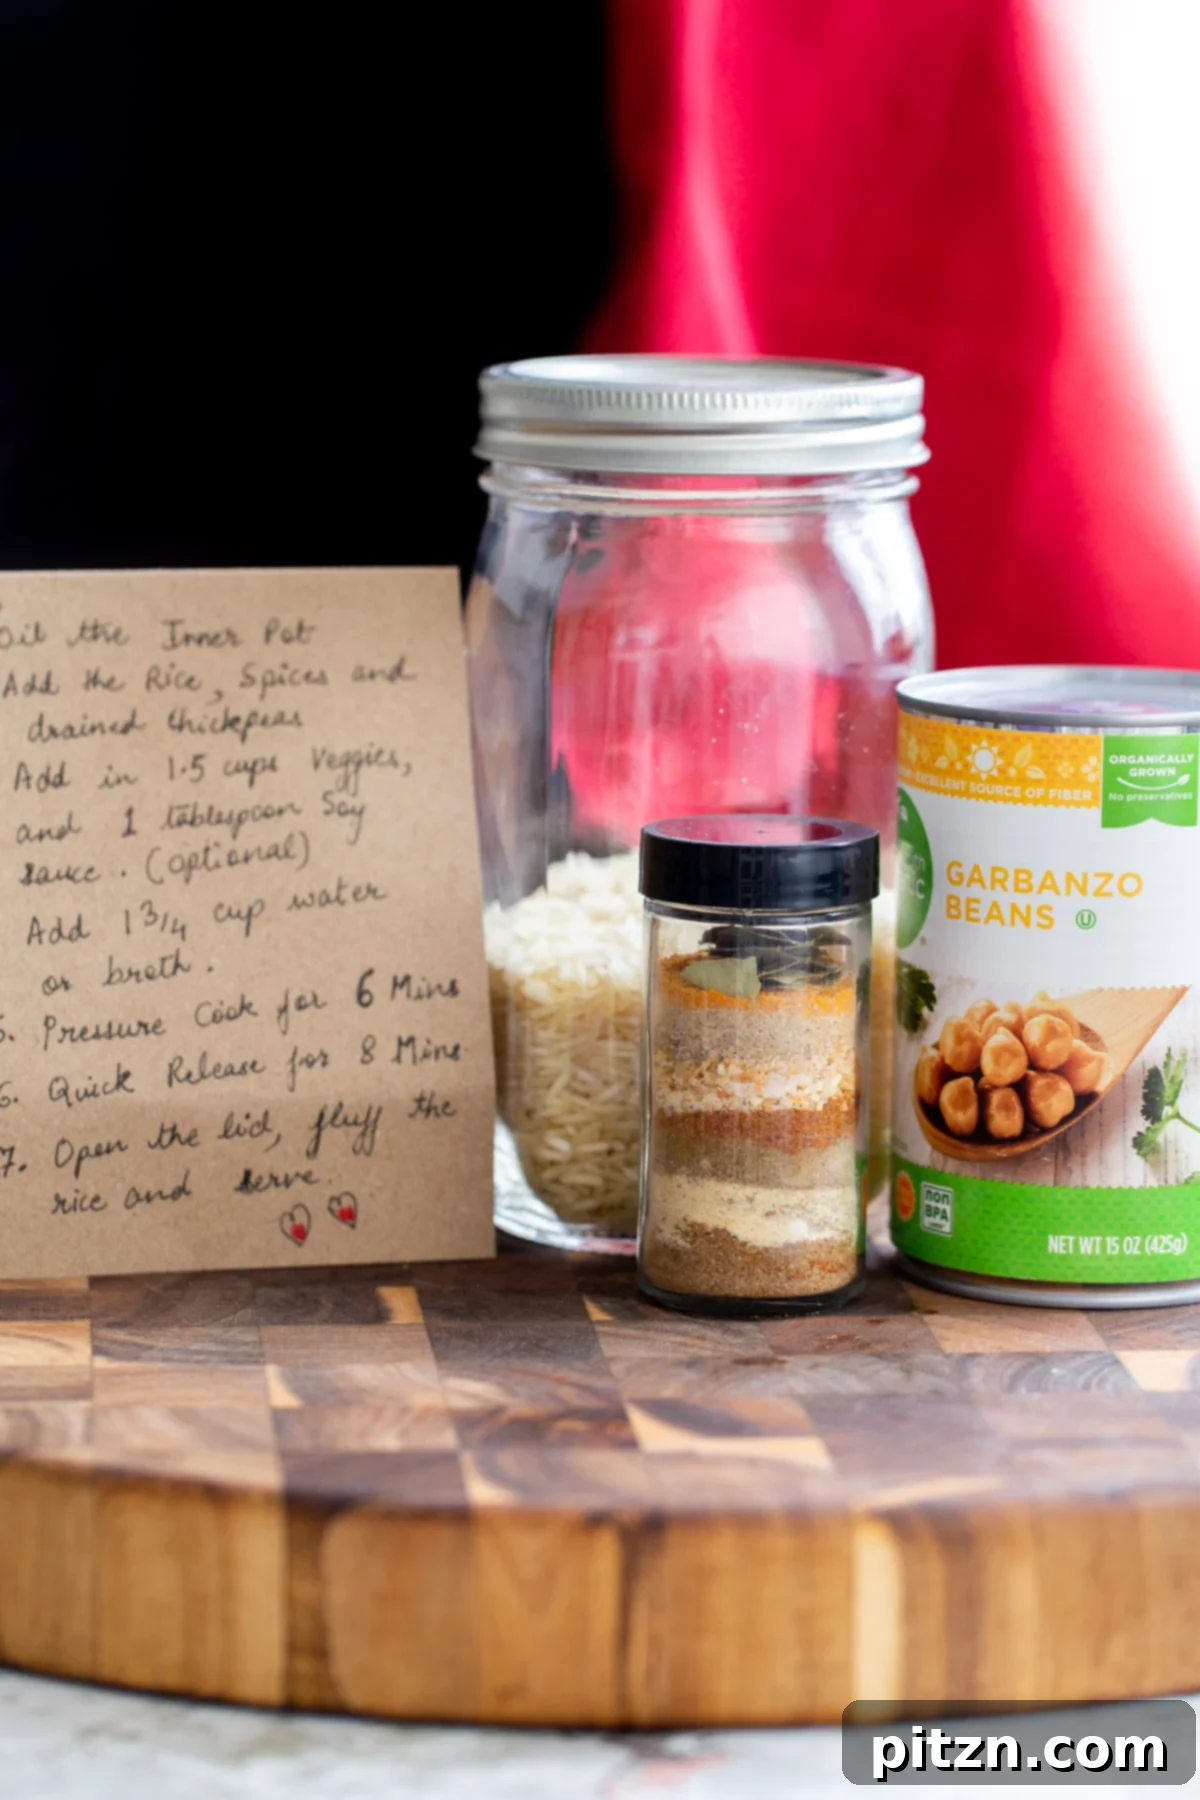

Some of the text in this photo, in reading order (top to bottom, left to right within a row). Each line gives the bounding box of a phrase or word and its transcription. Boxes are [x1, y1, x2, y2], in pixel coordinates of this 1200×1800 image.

[66, 619, 129, 648] the
[162, 620, 243, 651] Inner
[264, 618, 316, 644] Pot
[3, 669, 60, 698] Add
[82, 666, 126, 692] the
[352, 656, 417, 682] and
[28, 708, 146, 743] drained
[14, 765, 71, 793] Add
[98, 760, 139, 789] in
[223, 754, 278, 789] cups
[1108, 753, 1194, 765] ORGANICALLY
[1129, 767, 1176, 777] GROWN
[969, 782, 1021, 798] SOURCE
[1025, 788, 1045, 799] OF
[1049, 789, 1092, 801] FIBER
[1109, 791, 1193, 803] No preservatives
[16, 813, 82, 844] and
[161, 801, 303, 839] tablespoon
[945, 860, 1144, 898] GARBANZO
[26, 914, 90, 946] Add
[213, 898, 265, 938] cup
[287, 878, 389, 912] water
[945, 894, 1055, 930] BEANS
[42, 974, 72, 996] or
[43, 1014, 167, 1051] Pressure
[276, 989, 327, 1035] for
[356, 968, 375, 1009] 6
[391, 972, 460, 1001] Mins
[48, 1062, 134, 1108] Quick
[167, 1056, 266, 1089] Release
[286, 1048, 330, 1093] for
[359, 1036, 376, 1064] 8
[392, 1035, 461, 1066] Mins
[54, 1138, 128, 1180] Open
[148, 1120, 200, 1150] the
[305, 1101, 383, 1160] fluff
[407, 1090, 458, 1119] the
[51, 1189, 107, 1215] rice
[124, 1172, 192, 1208] and
[925, 1189, 950, 1206] non
[925, 1204, 949, 1222] BPA
[1048, 1232, 1188, 1256] NET WT 15 OZ (425g)
